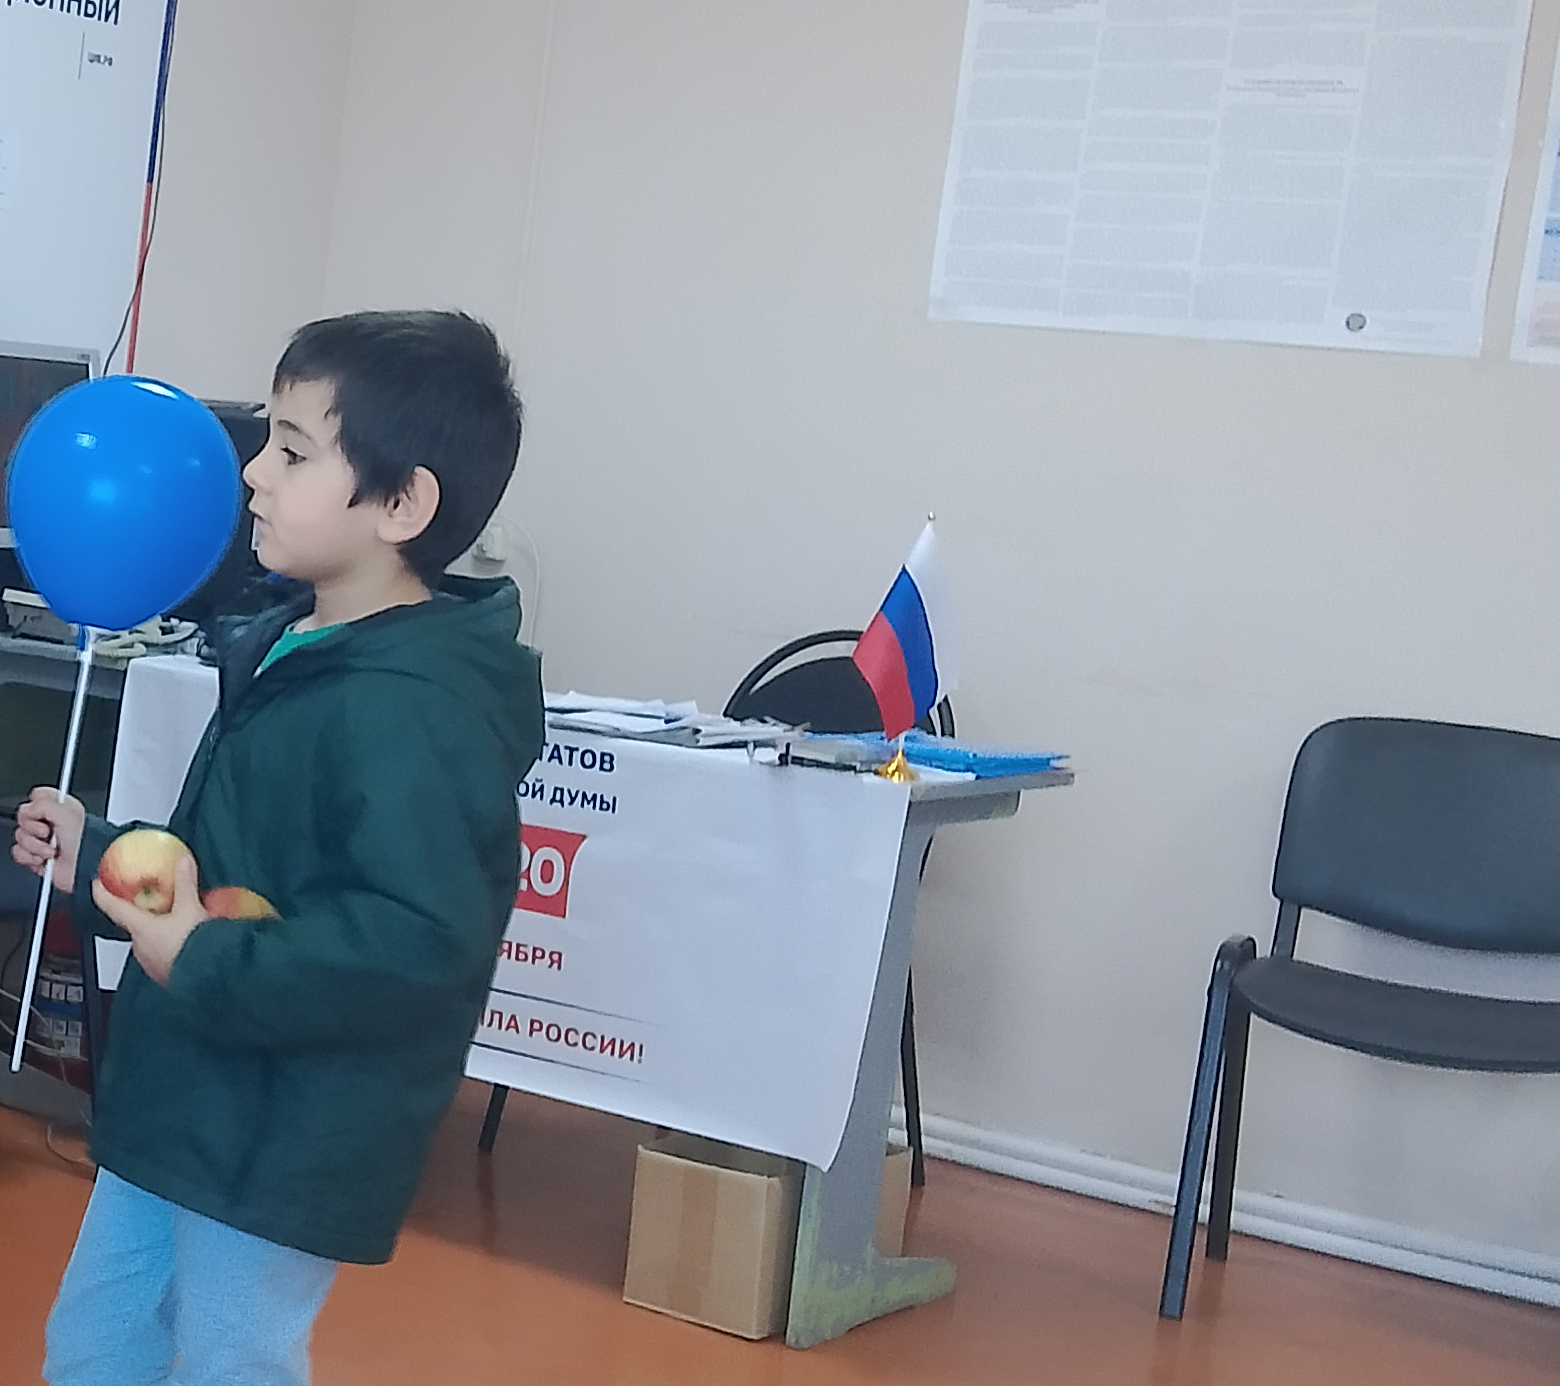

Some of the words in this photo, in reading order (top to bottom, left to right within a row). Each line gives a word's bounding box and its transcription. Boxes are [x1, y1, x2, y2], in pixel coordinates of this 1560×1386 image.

[517, 778, 545, 801] ОЙ
[550, 787, 617, 814] ДУМЫ
[529, 1019, 644, 1064] РОССИИ!
